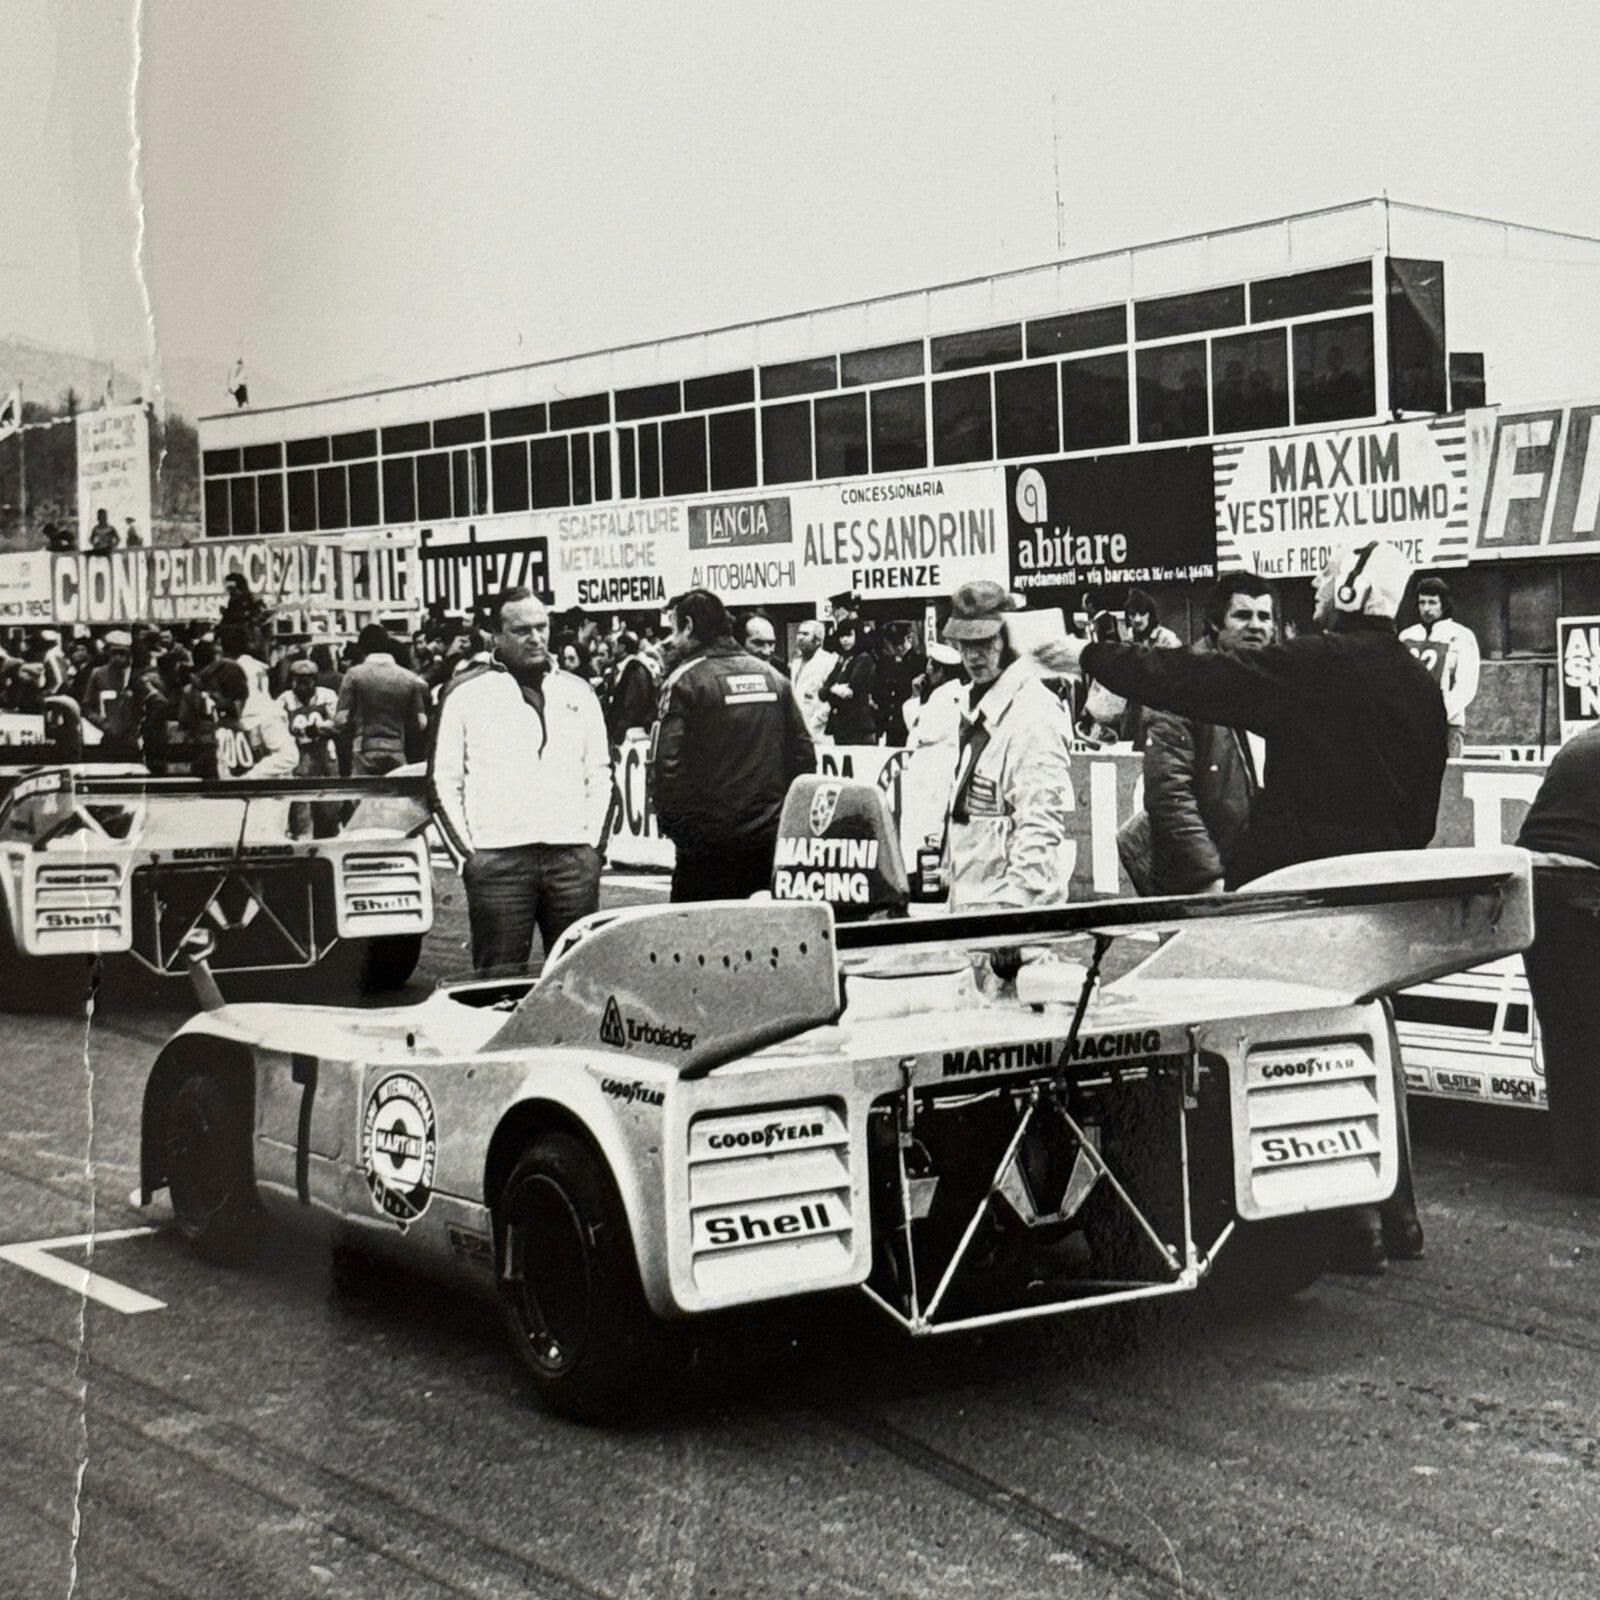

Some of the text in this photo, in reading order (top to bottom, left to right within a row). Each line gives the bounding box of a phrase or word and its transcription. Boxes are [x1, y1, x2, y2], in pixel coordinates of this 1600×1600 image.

[1269, 432, 1400, 494] MAXIM
[841, 480, 944, 505] CONCESSIONARIA
[558, 506, 681, 542] SCAFFALATURE
[706, 504, 769, 544] LANCIA
[803, 507, 996, 567] ALESSANDRINI
[560, 541, 656, 572] METALLICHE
[1018, 526, 1128, 569] abitare
[54, 550, 150, 623] CIONI
[577, 575, 667, 605] SCARPERIA
[691, 560, 796, 590] AUTOBIANCHI
[852, 564, 942, 591] FIRENZE
[1104, 565, 1150, 583] baracca
[777, 837, 878, 870] MARTINI
[774, 871, 870, 904] RACING
[625, 1016, 697, 1051] Turbolader
[942, 1030, 1162, 1077] MARTINI RACING
[1262, 1056, 1354, 1079] GOODYEAR
[1436, 1073, 1482, 1088] BILSTEIN
[1491, 1076, 1537, 1097] BOSCH
[707, 1121, 824, 1150] GOODYEAR
[1261, 1128, 1363, 1163] Shell
[704, 1203, 832, 1246] Shell
